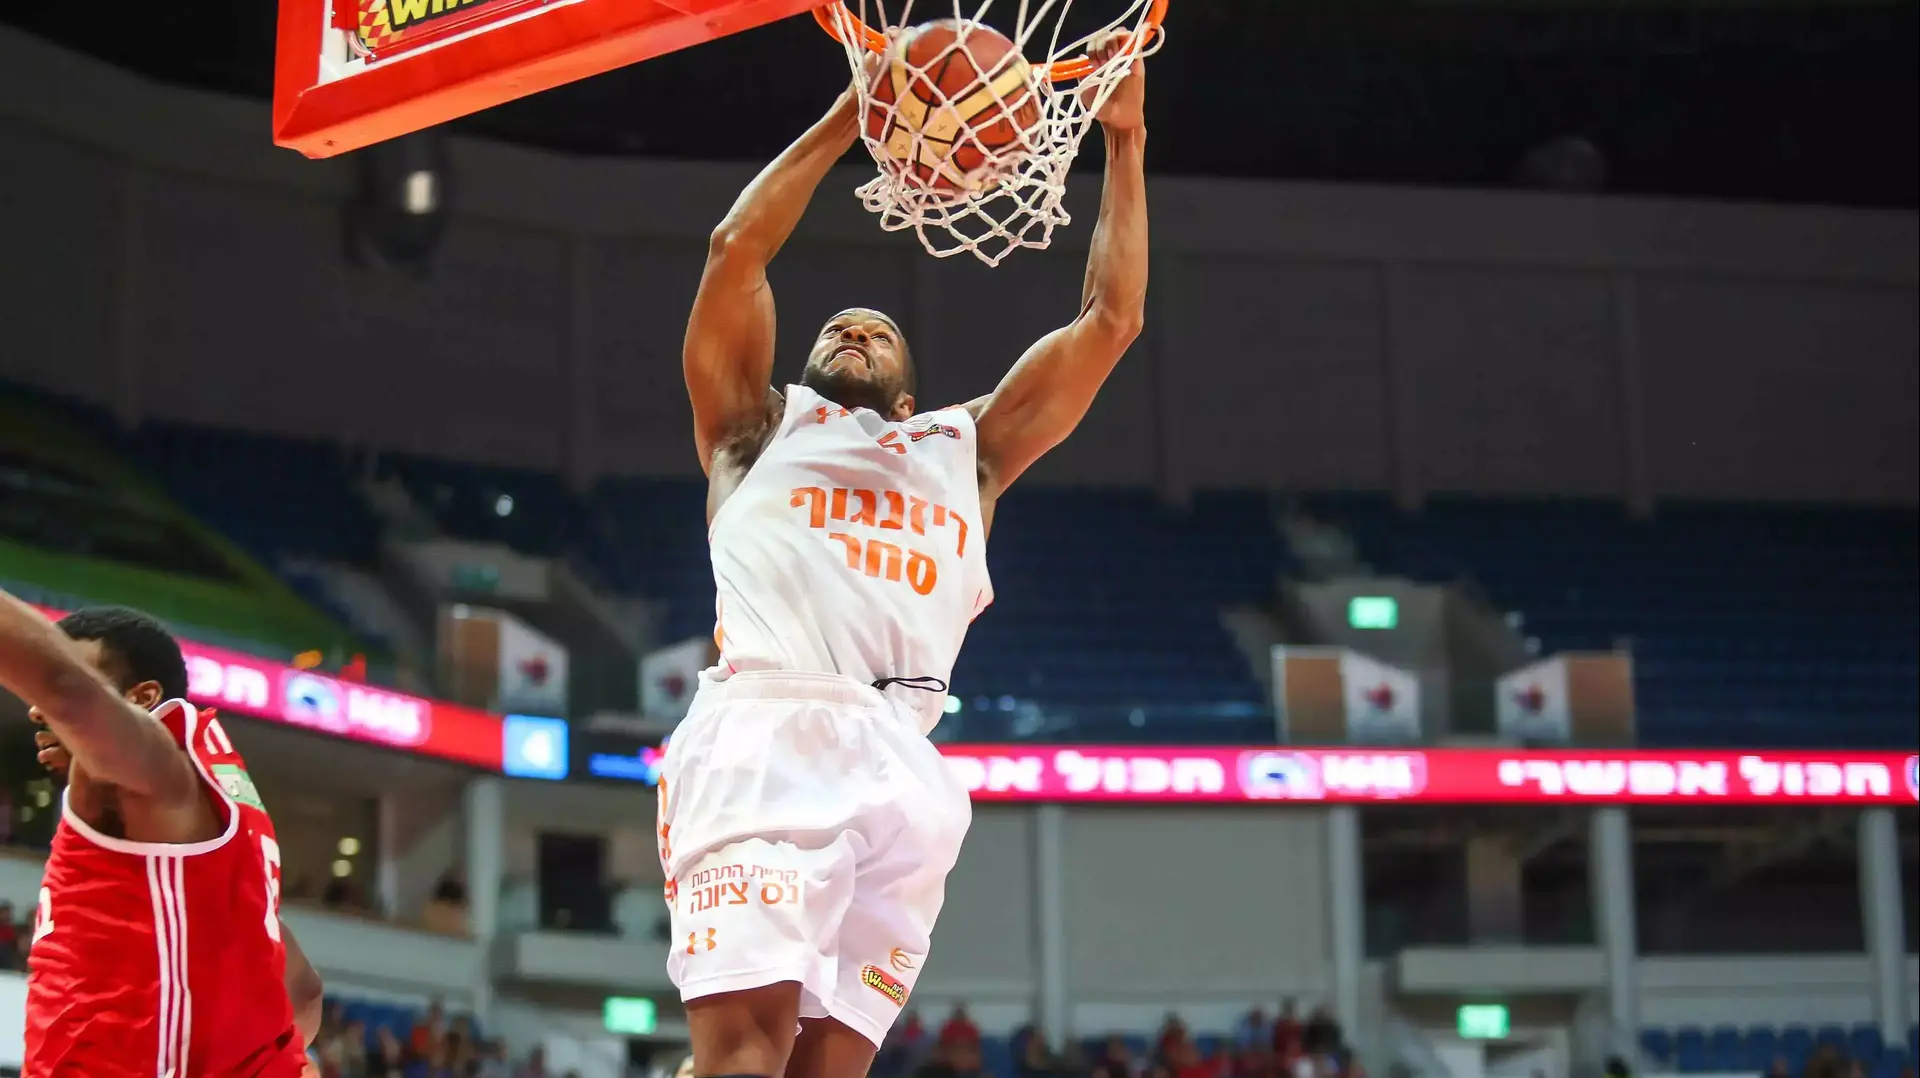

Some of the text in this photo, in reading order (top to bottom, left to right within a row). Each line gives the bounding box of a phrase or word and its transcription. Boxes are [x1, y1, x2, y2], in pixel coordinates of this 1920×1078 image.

[829, 532, 938, 596] סחר
[691, 864, 744, 888] התרבות
[689, 881, 798, 914] נס ציונה
[868, 971, 900, 1001] Winner
